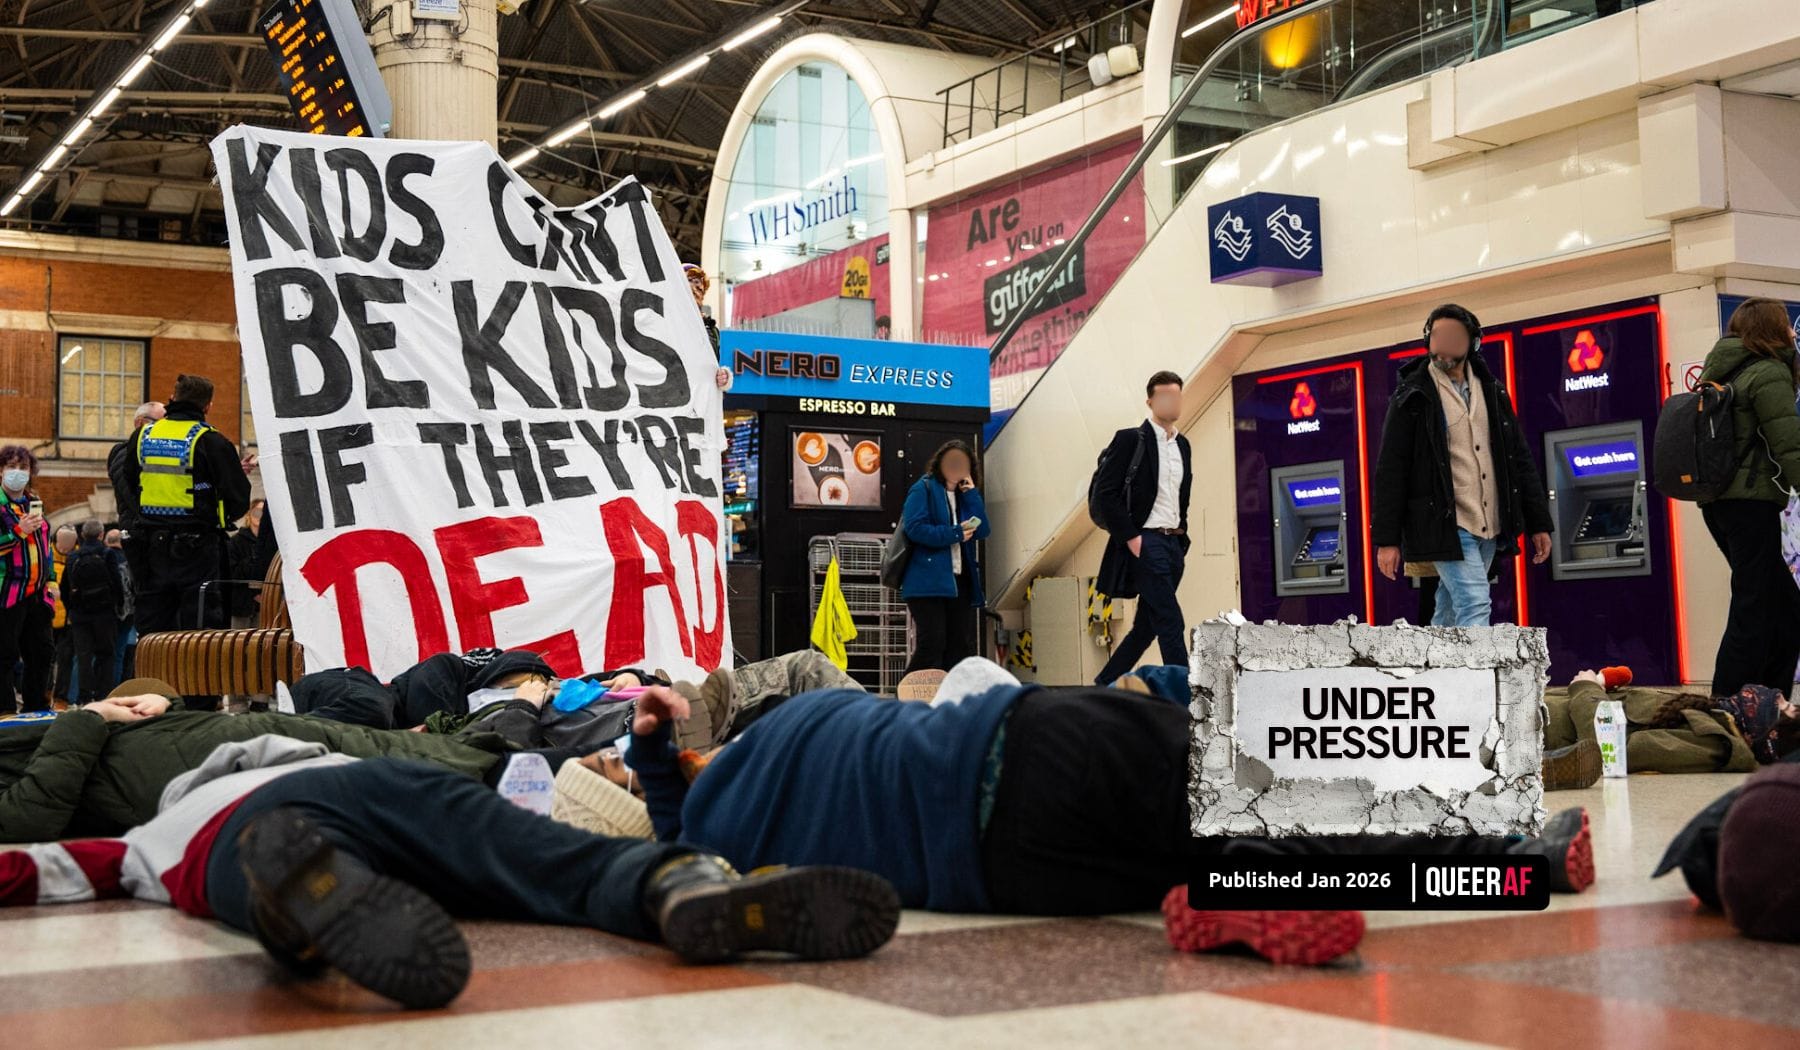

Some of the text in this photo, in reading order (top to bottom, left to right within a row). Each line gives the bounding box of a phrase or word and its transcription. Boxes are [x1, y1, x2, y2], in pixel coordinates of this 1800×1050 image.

[226, 137, 445, 270] KIDS
[749, 175, 858, 245] WHSmith
[967, 198, 1020, 251] Are
[1007, 221, 1064, 257] you on
[253, 267, 691, 418] BE KIDS
[733, 349, 954, 388] NERO EXPRESS
[1565, 373, 1609, 392] NatWest
[799, 398, 896, 416] ESPRESSO BAR
[1288, 420, 1320, 435] NatWest
[279, 415, 718, 532] IF THEY'RE
[1574, 452, 1635, 467] Get cash here
[1294, 486, 1341, 499] Get cash here
[299, 496, 724, 687] DEAD
